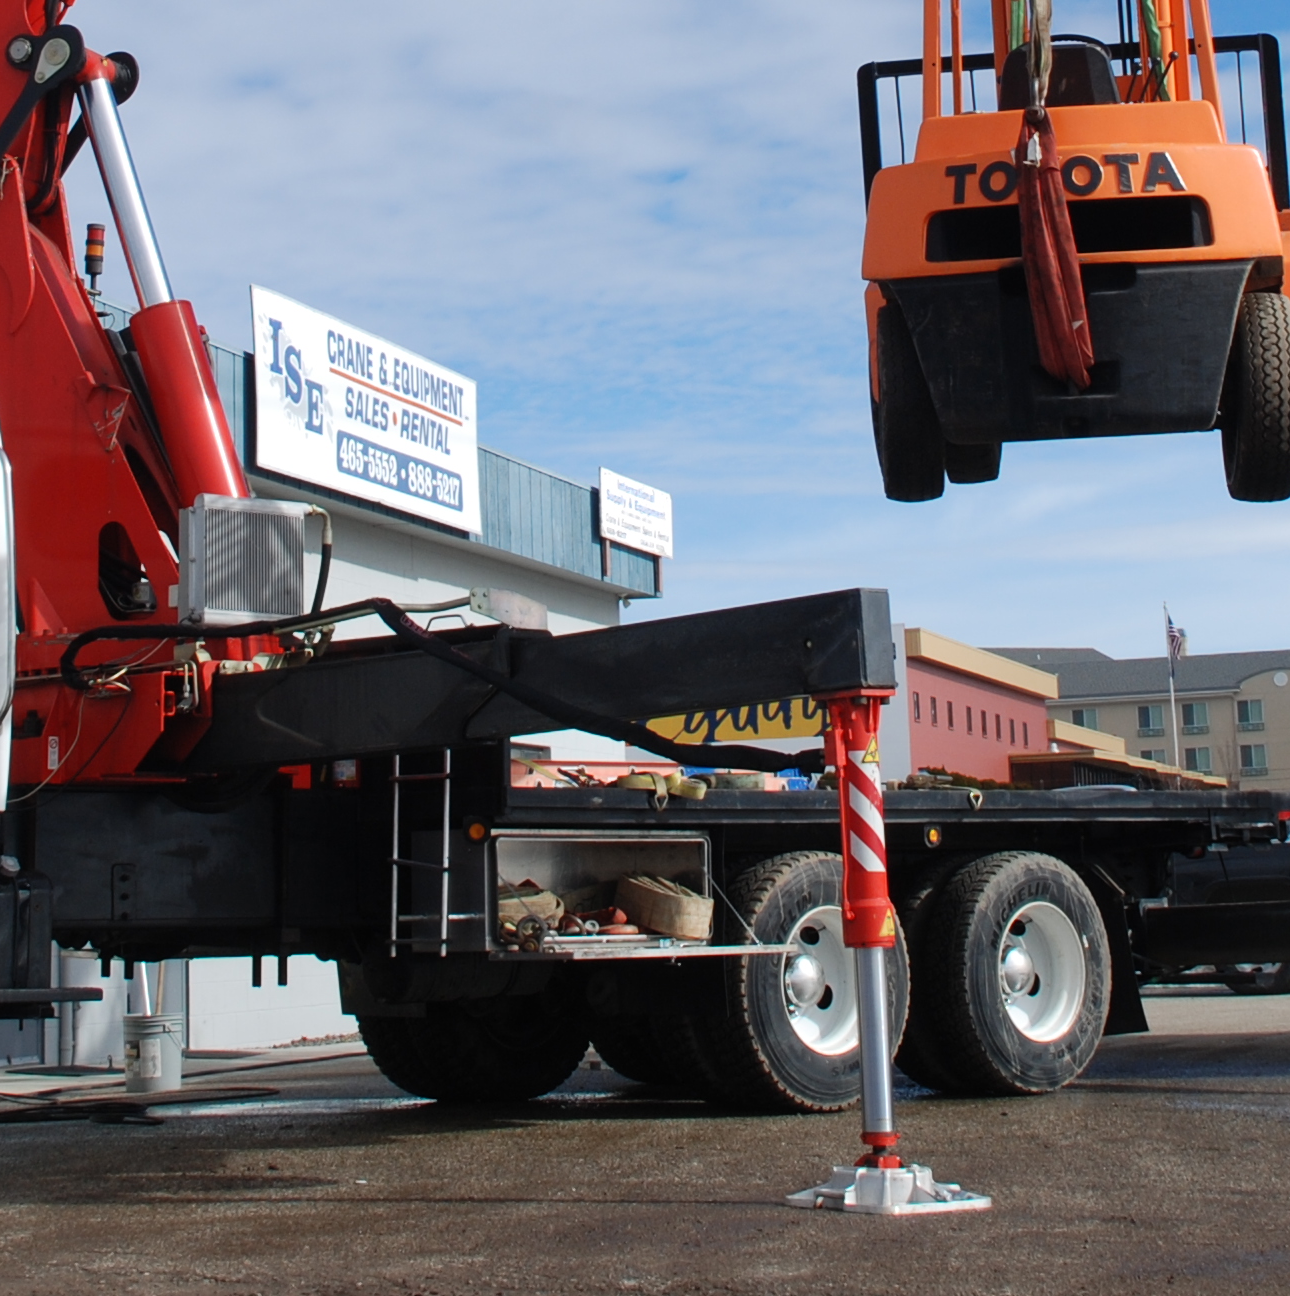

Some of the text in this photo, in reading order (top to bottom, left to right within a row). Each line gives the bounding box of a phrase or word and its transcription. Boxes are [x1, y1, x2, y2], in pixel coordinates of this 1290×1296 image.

[945, 151, 1187, 204] TOOTA
[327, 329, 464, 419] CRANE & EQUIPMENT
[345, 386, 451, 456] SALES RENTAL
[339, 437, 461, 507] 465-5552 888-5217
